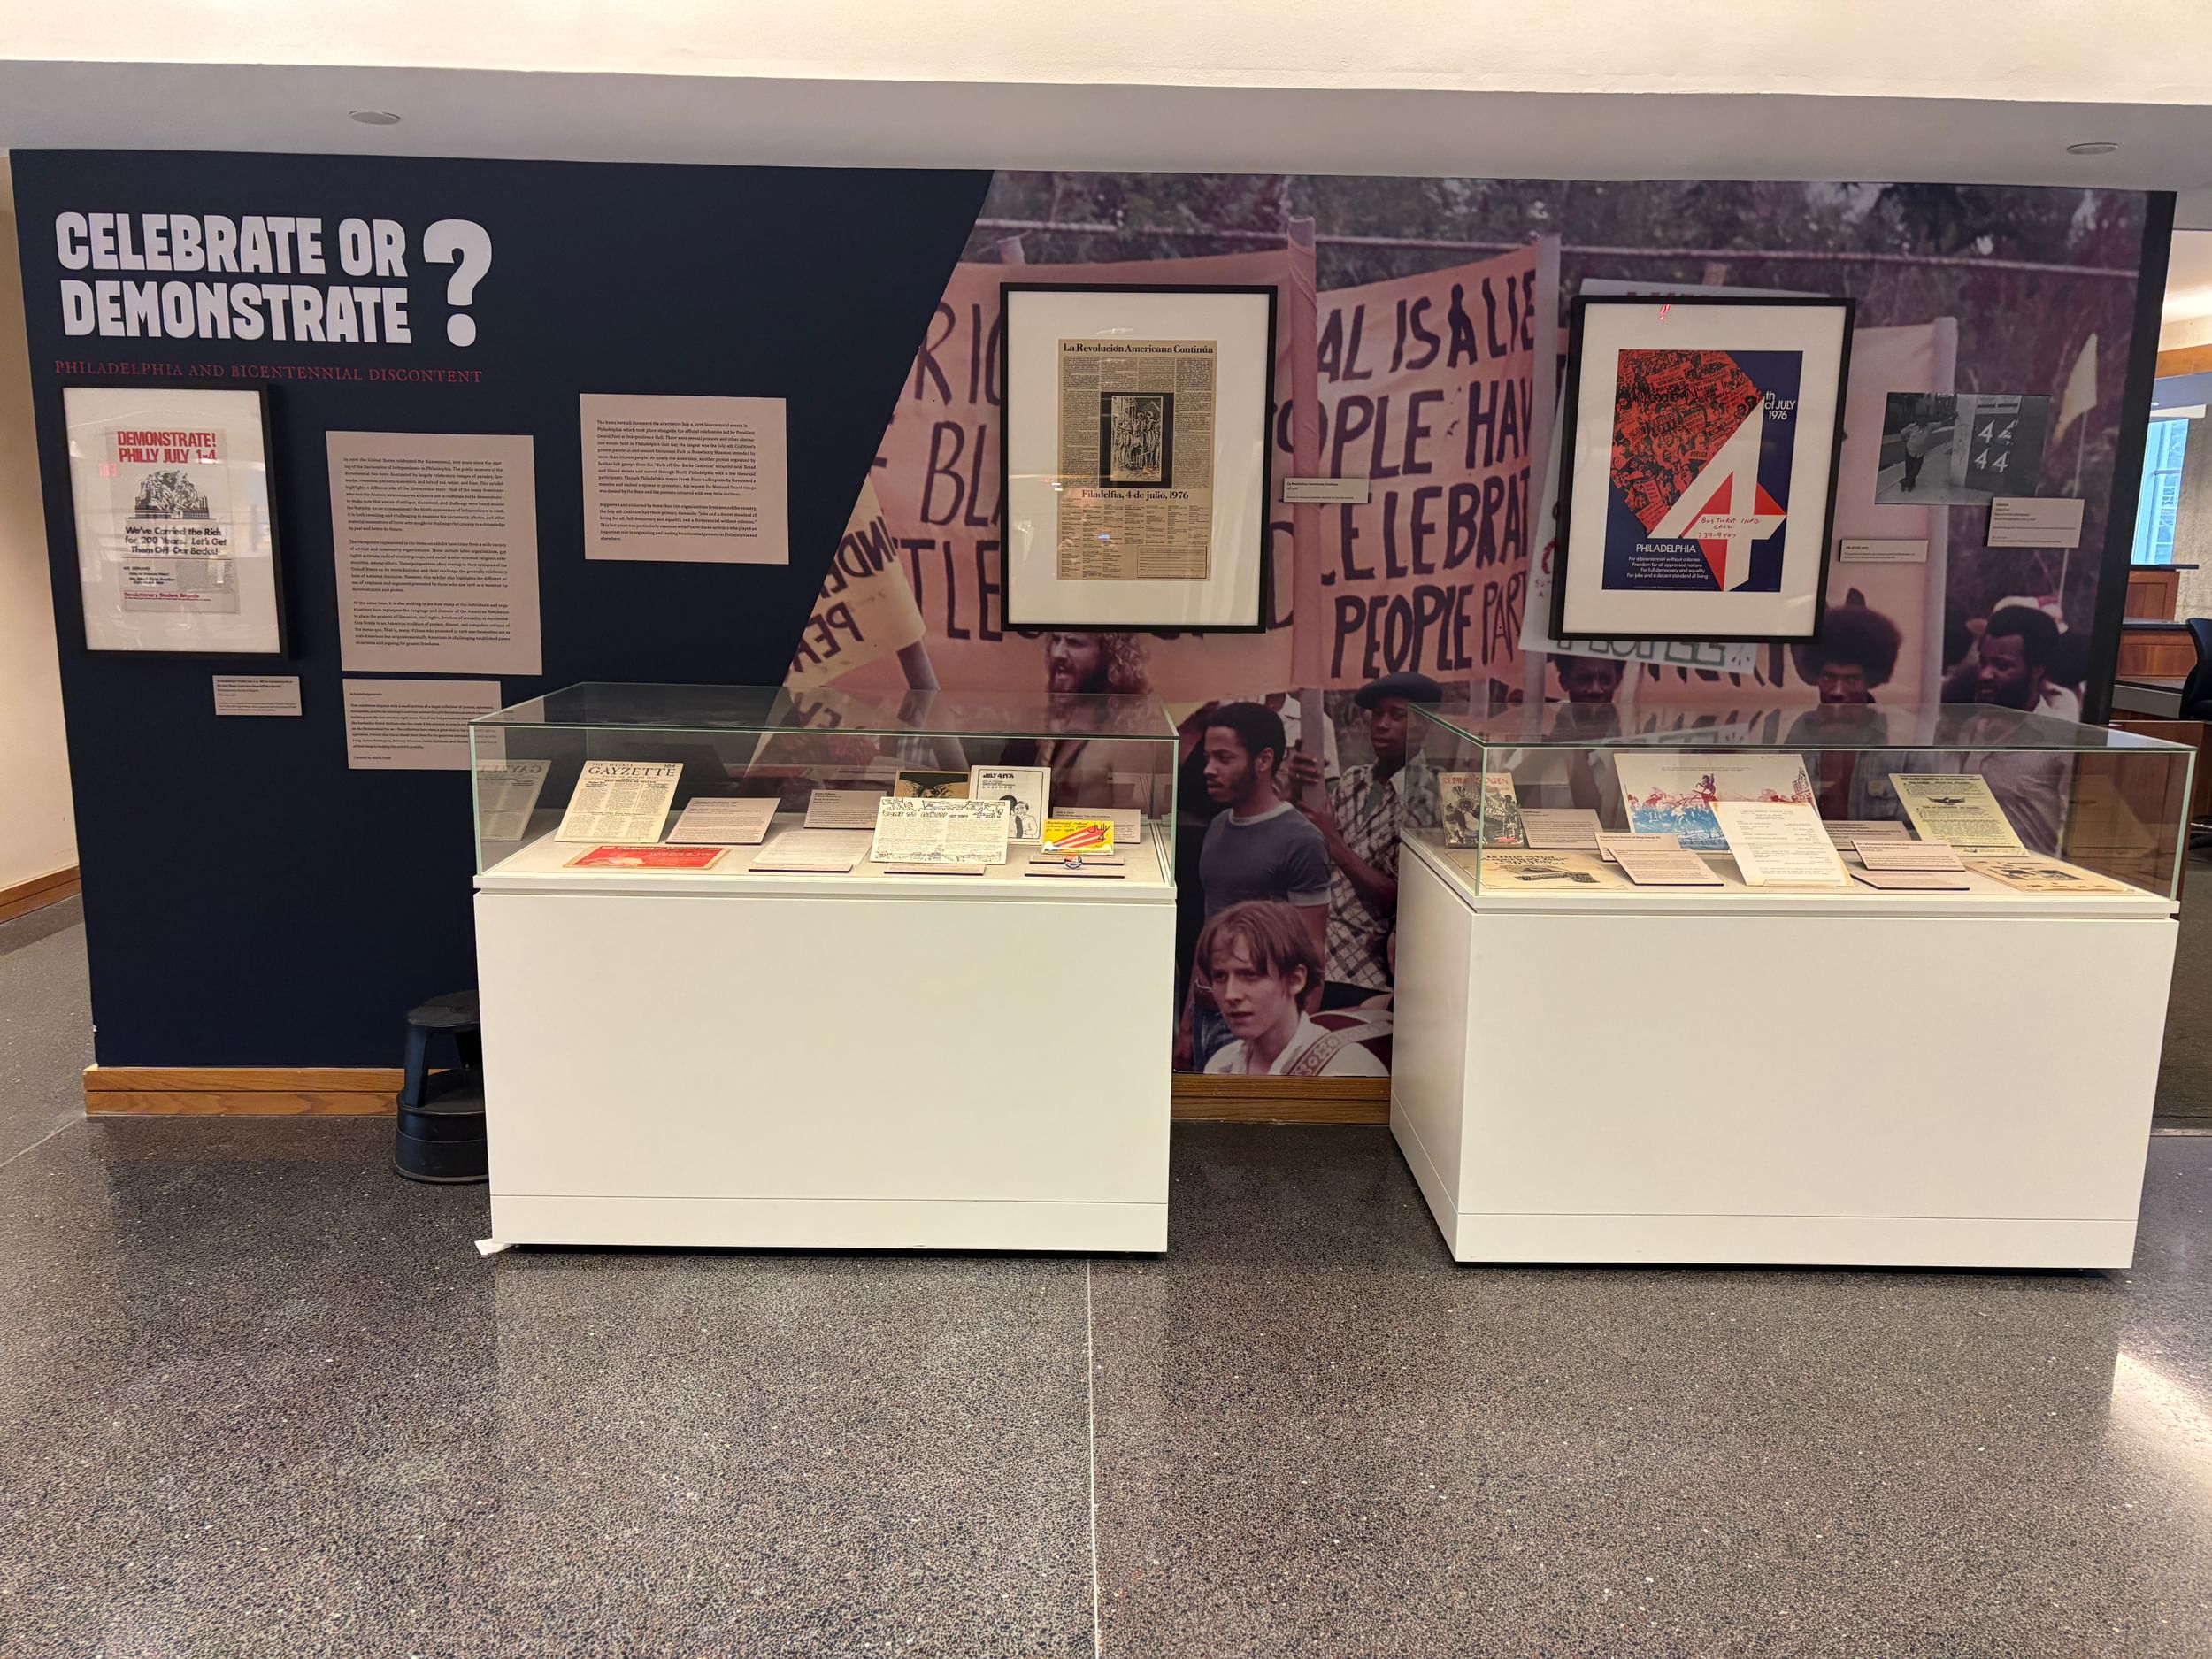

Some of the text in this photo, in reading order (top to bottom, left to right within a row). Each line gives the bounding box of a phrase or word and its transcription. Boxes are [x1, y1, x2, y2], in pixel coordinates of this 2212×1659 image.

[55, 211, 408, 278] CELEBRATE OR
[422, 219, 493, 347] ?
[60, 280, 411, 344] DEMONSTRATE
[1447, 283, 1478, 367] A
[1064, 342, 1213, 353] La Revolución Americana Continúa
[54, 361, 482, 383] PHILADELPHIA AND BICENTENNIAL DISCONTENT
[1765, 390, 1775, 401] th
[1764, 400, 1796, 410] of JULY
[1769, 410, 1787, 420] 1976
[117, 432, 216, 448] DEMONSTRATE!
[119, 449, 217, 464] PHILLY JULY 1-4
[1082, 489, 1188, 501] Filadelfia, 4 de julio, 1976
[204, 527, 221, 536] Rich
[1636, 544, 1696, 553] PHILADELPHIA
[1331, 584, 1472, 679] PEOPLE
[588, 766, 676, 777] GAYZETTE
